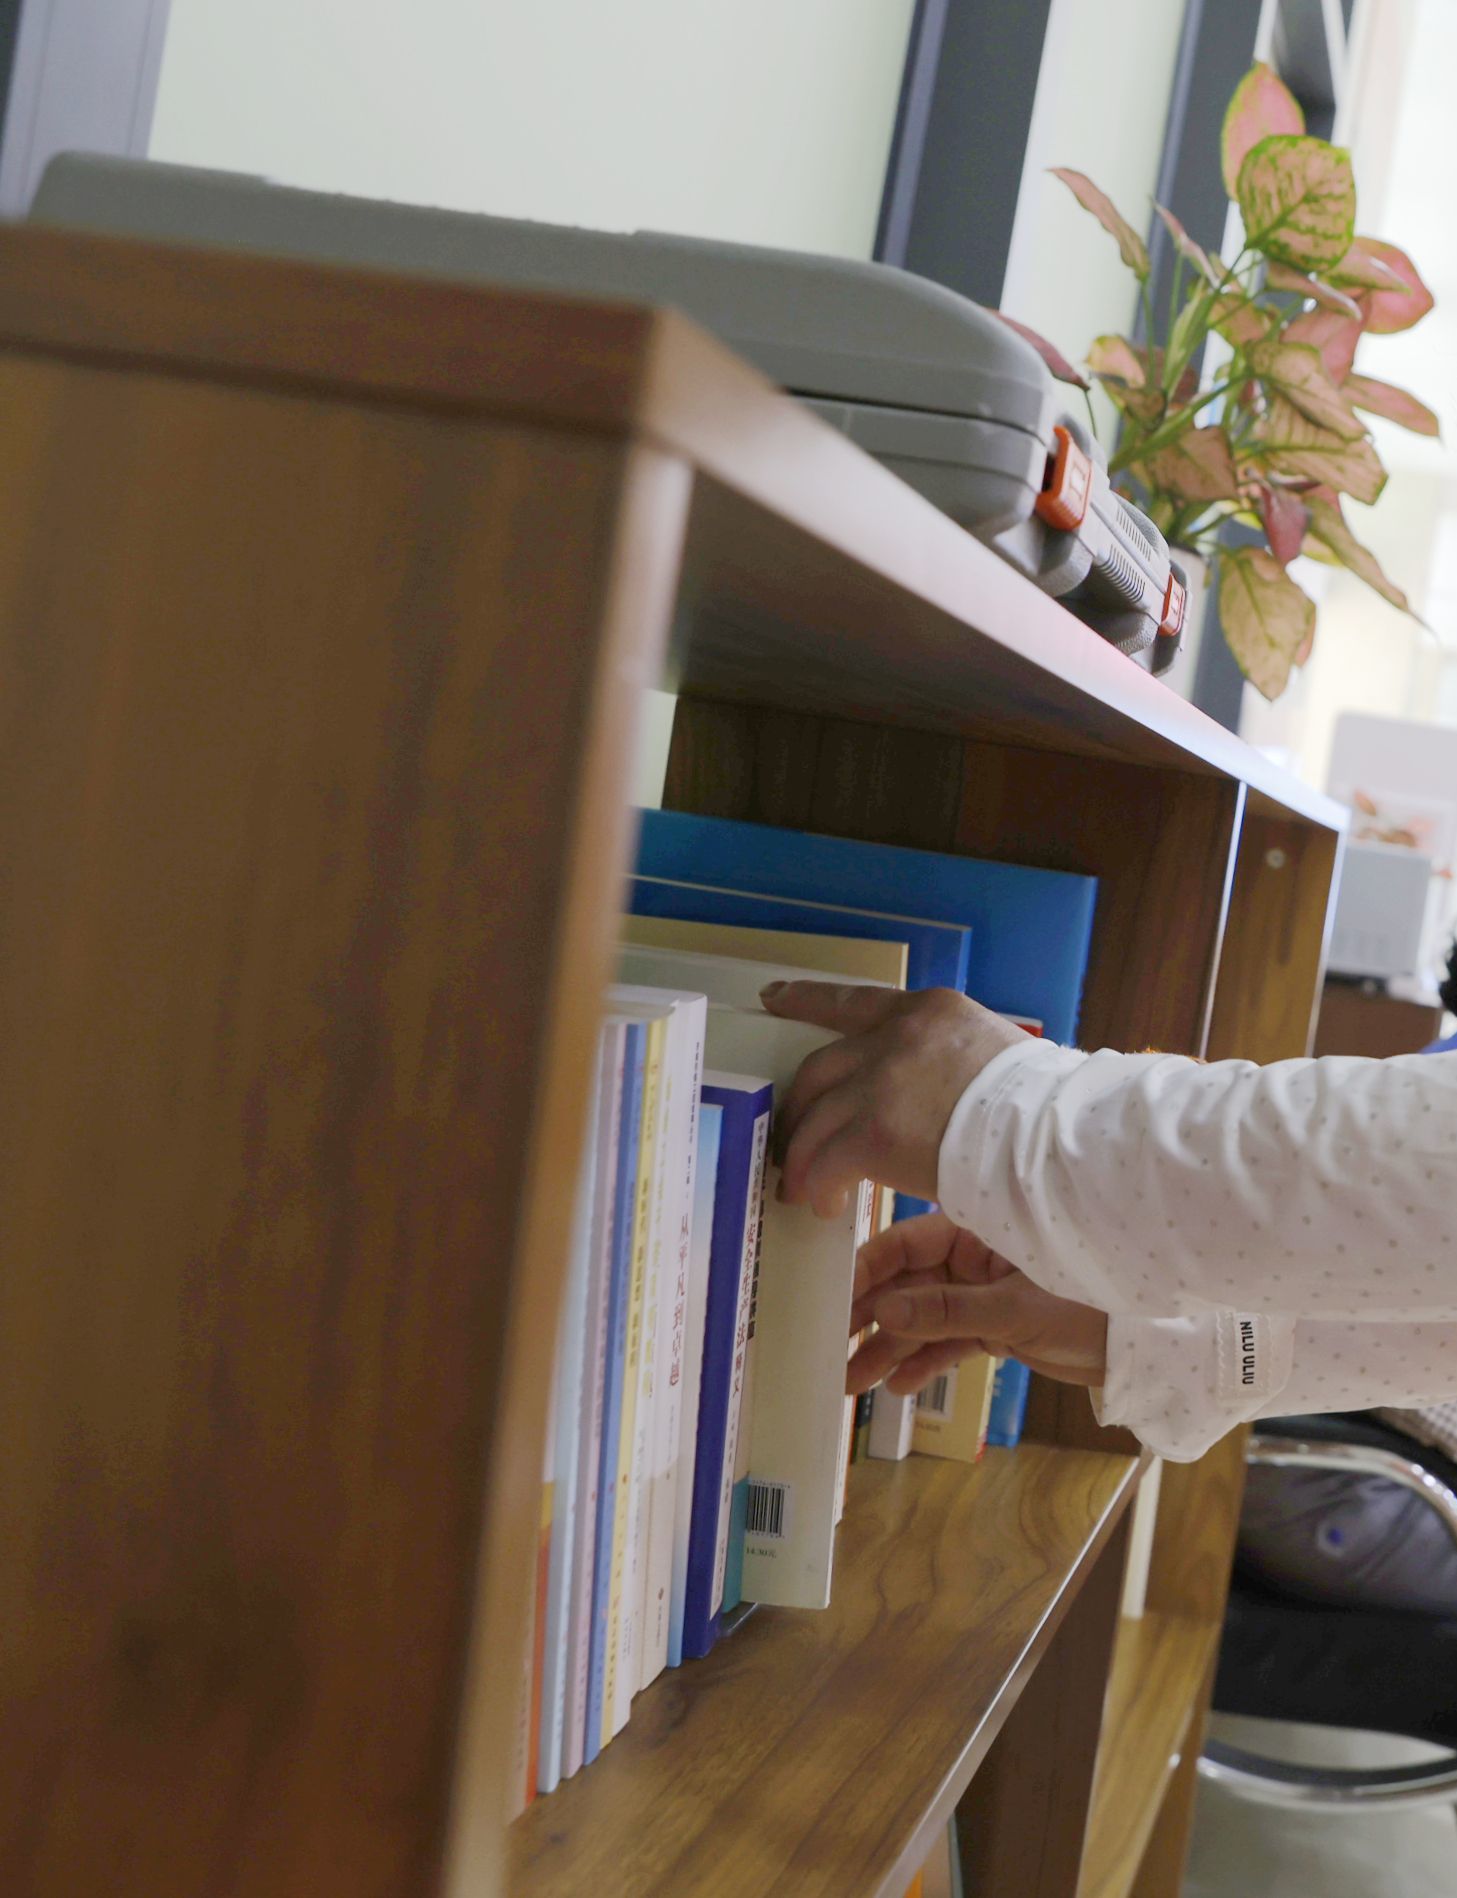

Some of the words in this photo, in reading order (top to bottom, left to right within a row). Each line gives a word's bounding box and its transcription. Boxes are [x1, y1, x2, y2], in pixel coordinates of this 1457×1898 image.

[669, 1213, 689, 1387] 从平凡到卓越
[1240, 1321, 1255, 1352] NILU
[1242, 1355, 1255, 1385] ULIU
